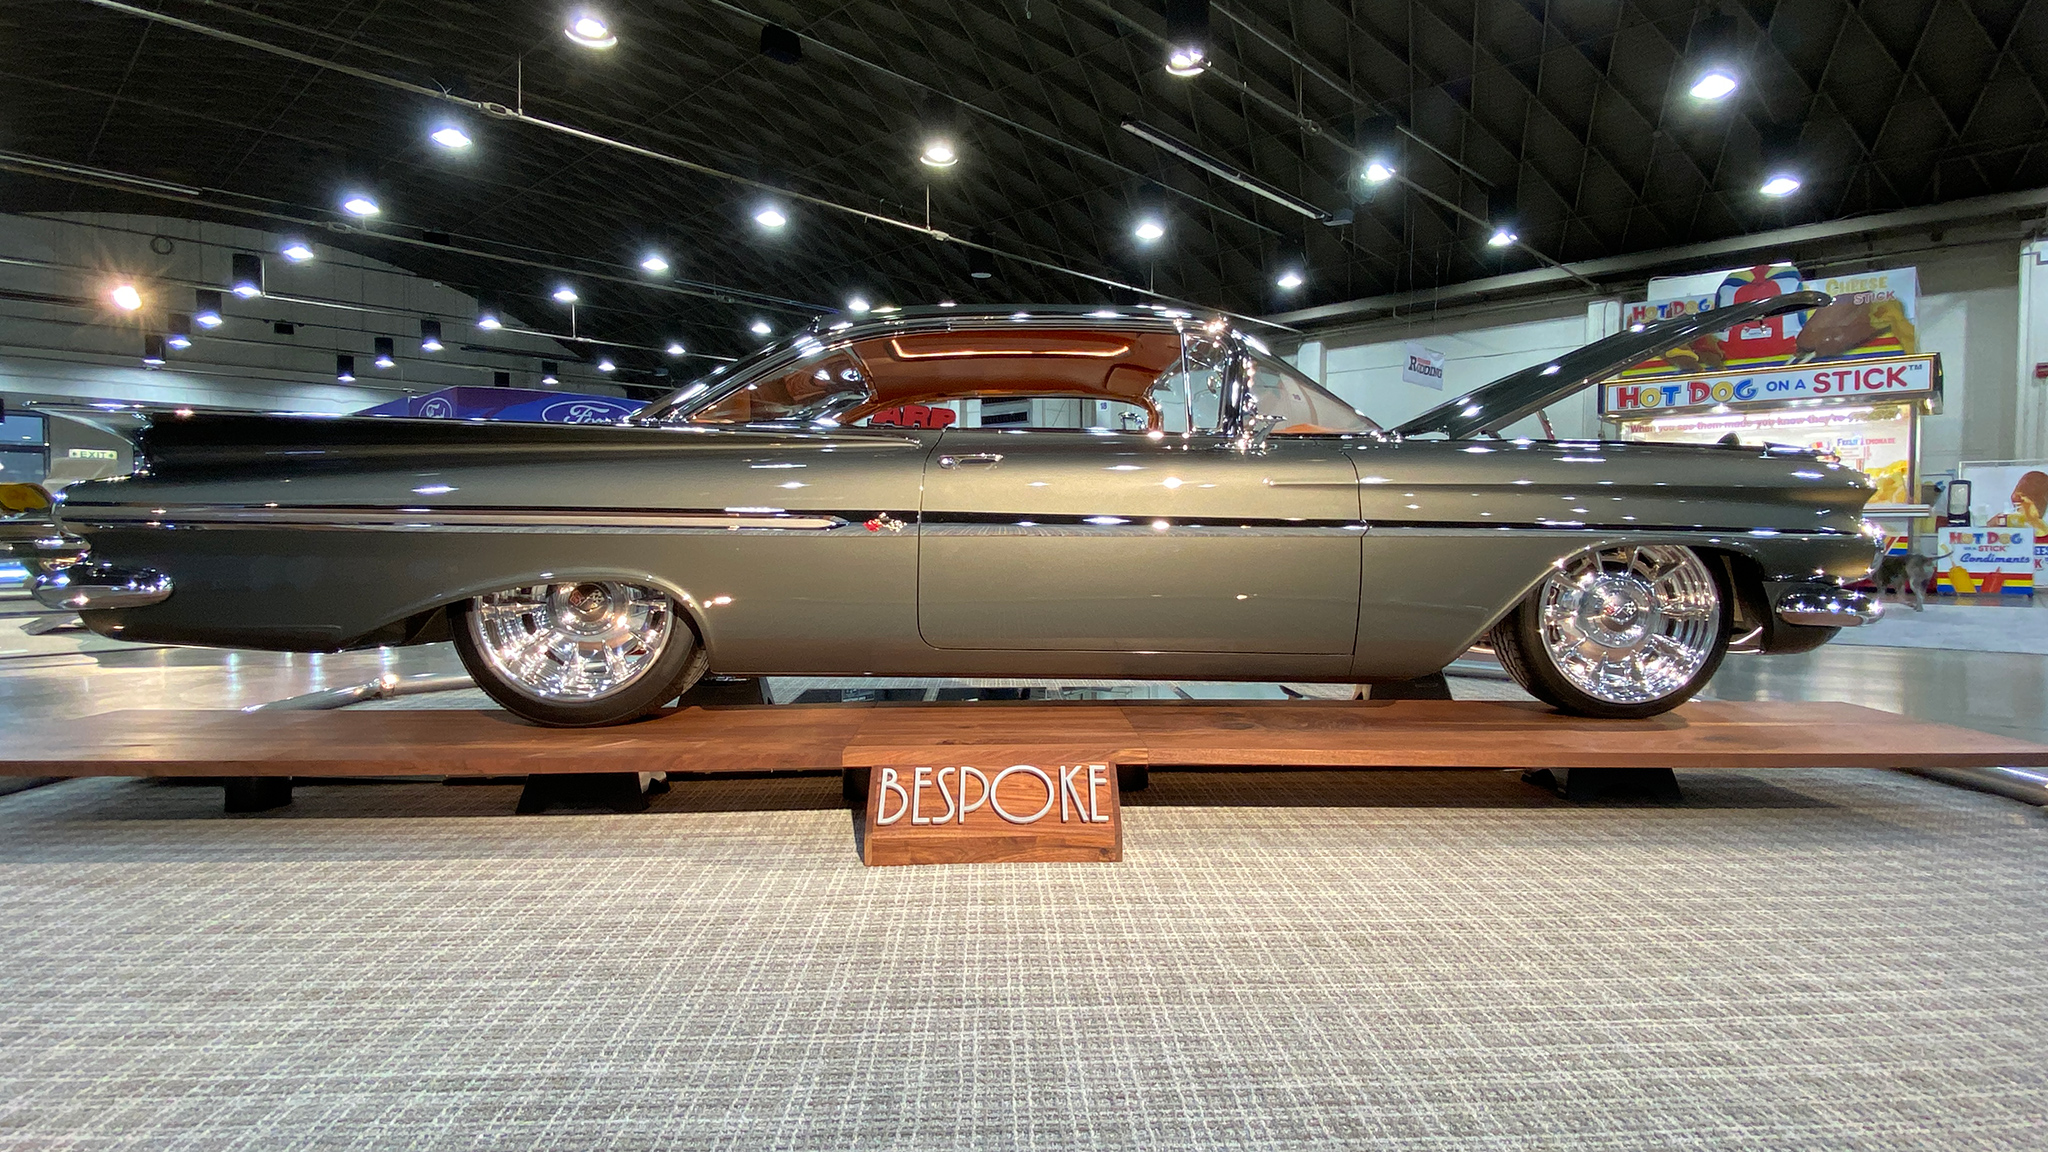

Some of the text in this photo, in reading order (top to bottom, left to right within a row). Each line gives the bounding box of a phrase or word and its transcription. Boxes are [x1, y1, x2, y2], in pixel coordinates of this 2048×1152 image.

[1825, 277, 1888, 296] CHEESE
[1854, 291, 1896, 305] STICK
[1632, 299, 1712, 321] HOT DOG
[1617, 385, 1681, 409] HOT
[1687, 378, 1758, 404] DOG
[1766, 380, 1789, 392] ON
[1794, 379, 1806, 390] A
[1813, 366, 1908, 393] STICK
[872, 405, 957, 429] ARP
[80, 451, 107, 459] EXIT
[1949, 532, 2023, 545] HOT DOG
[1960, 552, 2031, 564] Condiments
[876, 764, 1110, 826] BESPOKE
